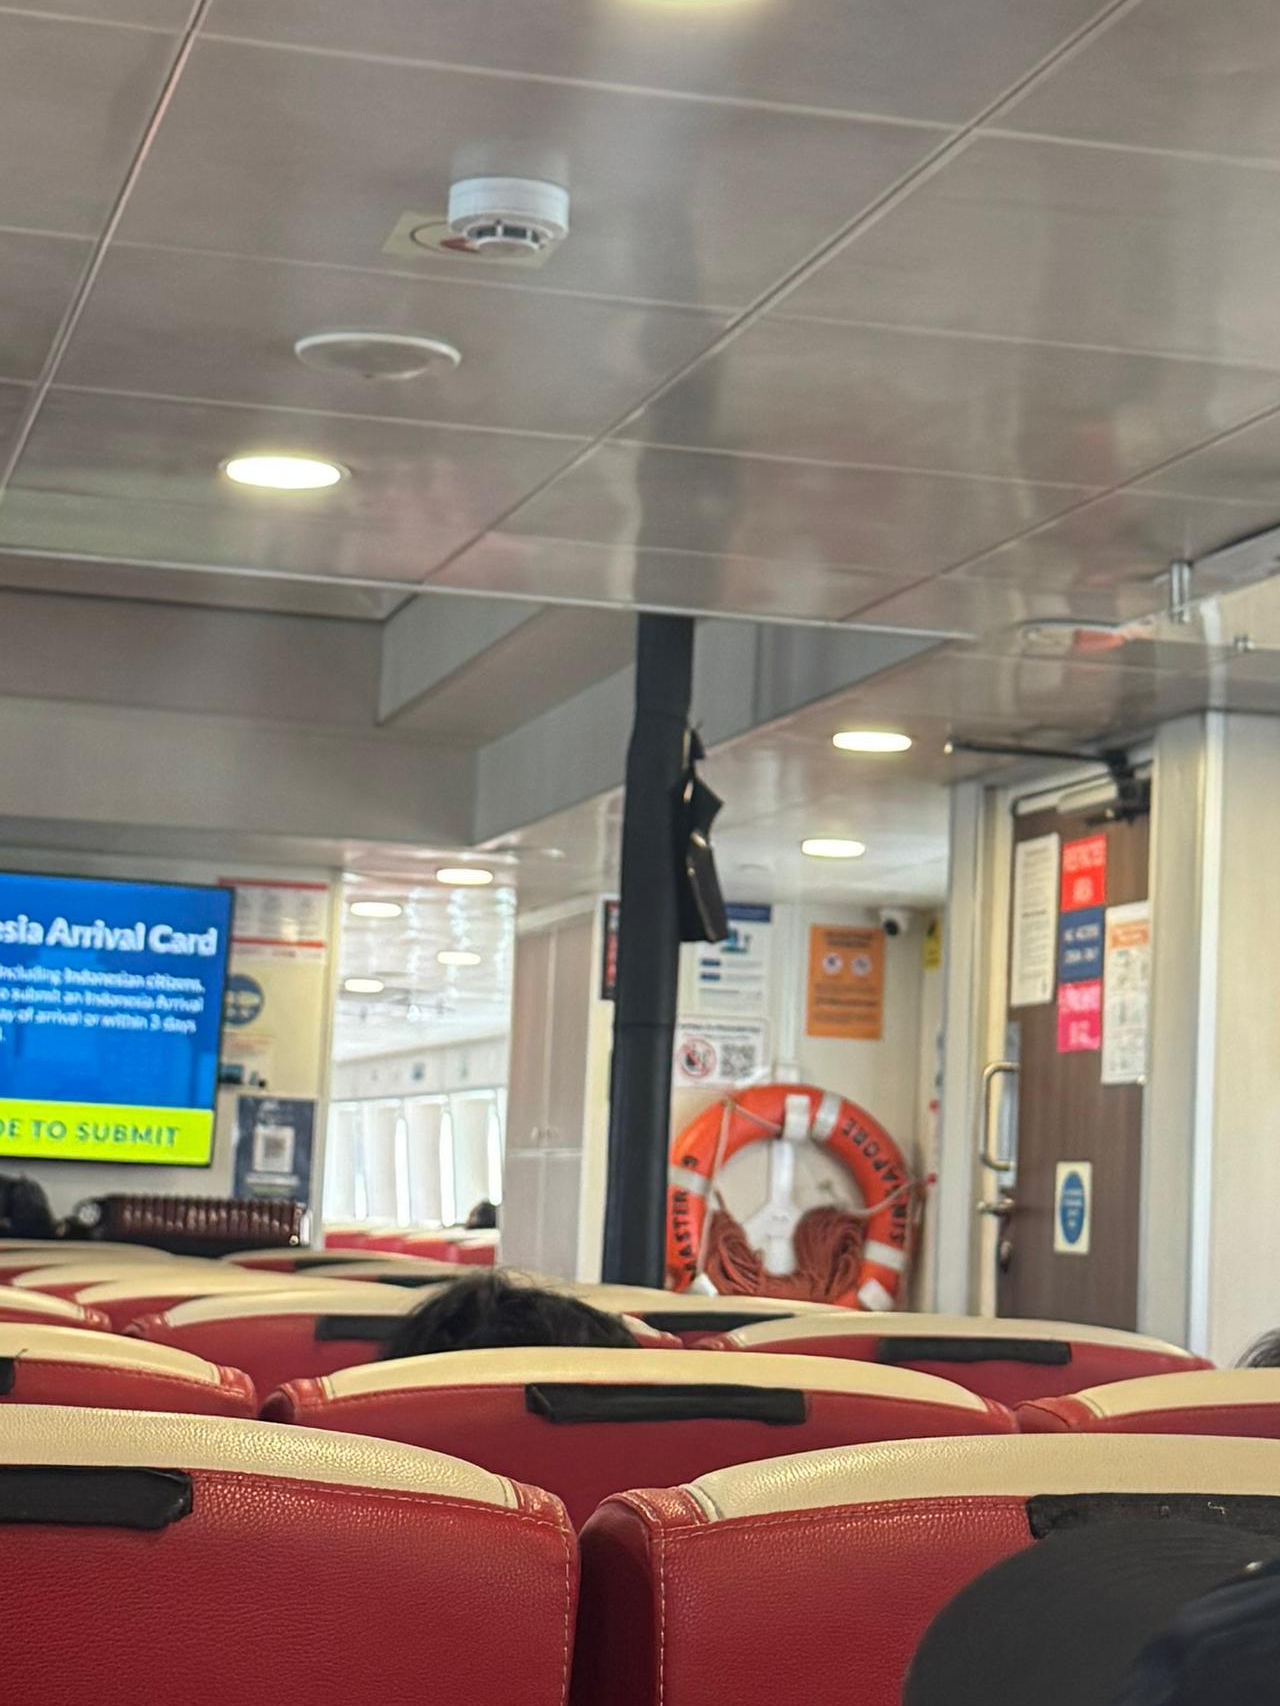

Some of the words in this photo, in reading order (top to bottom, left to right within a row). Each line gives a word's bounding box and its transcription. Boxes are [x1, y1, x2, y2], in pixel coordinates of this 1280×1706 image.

[46, 917, 146, 951] Arrival
[149, 924, 218, 956] Card
[31, 1119, 67, 1141] TO
[76, 1121, 180, 1147] SUBMIT
